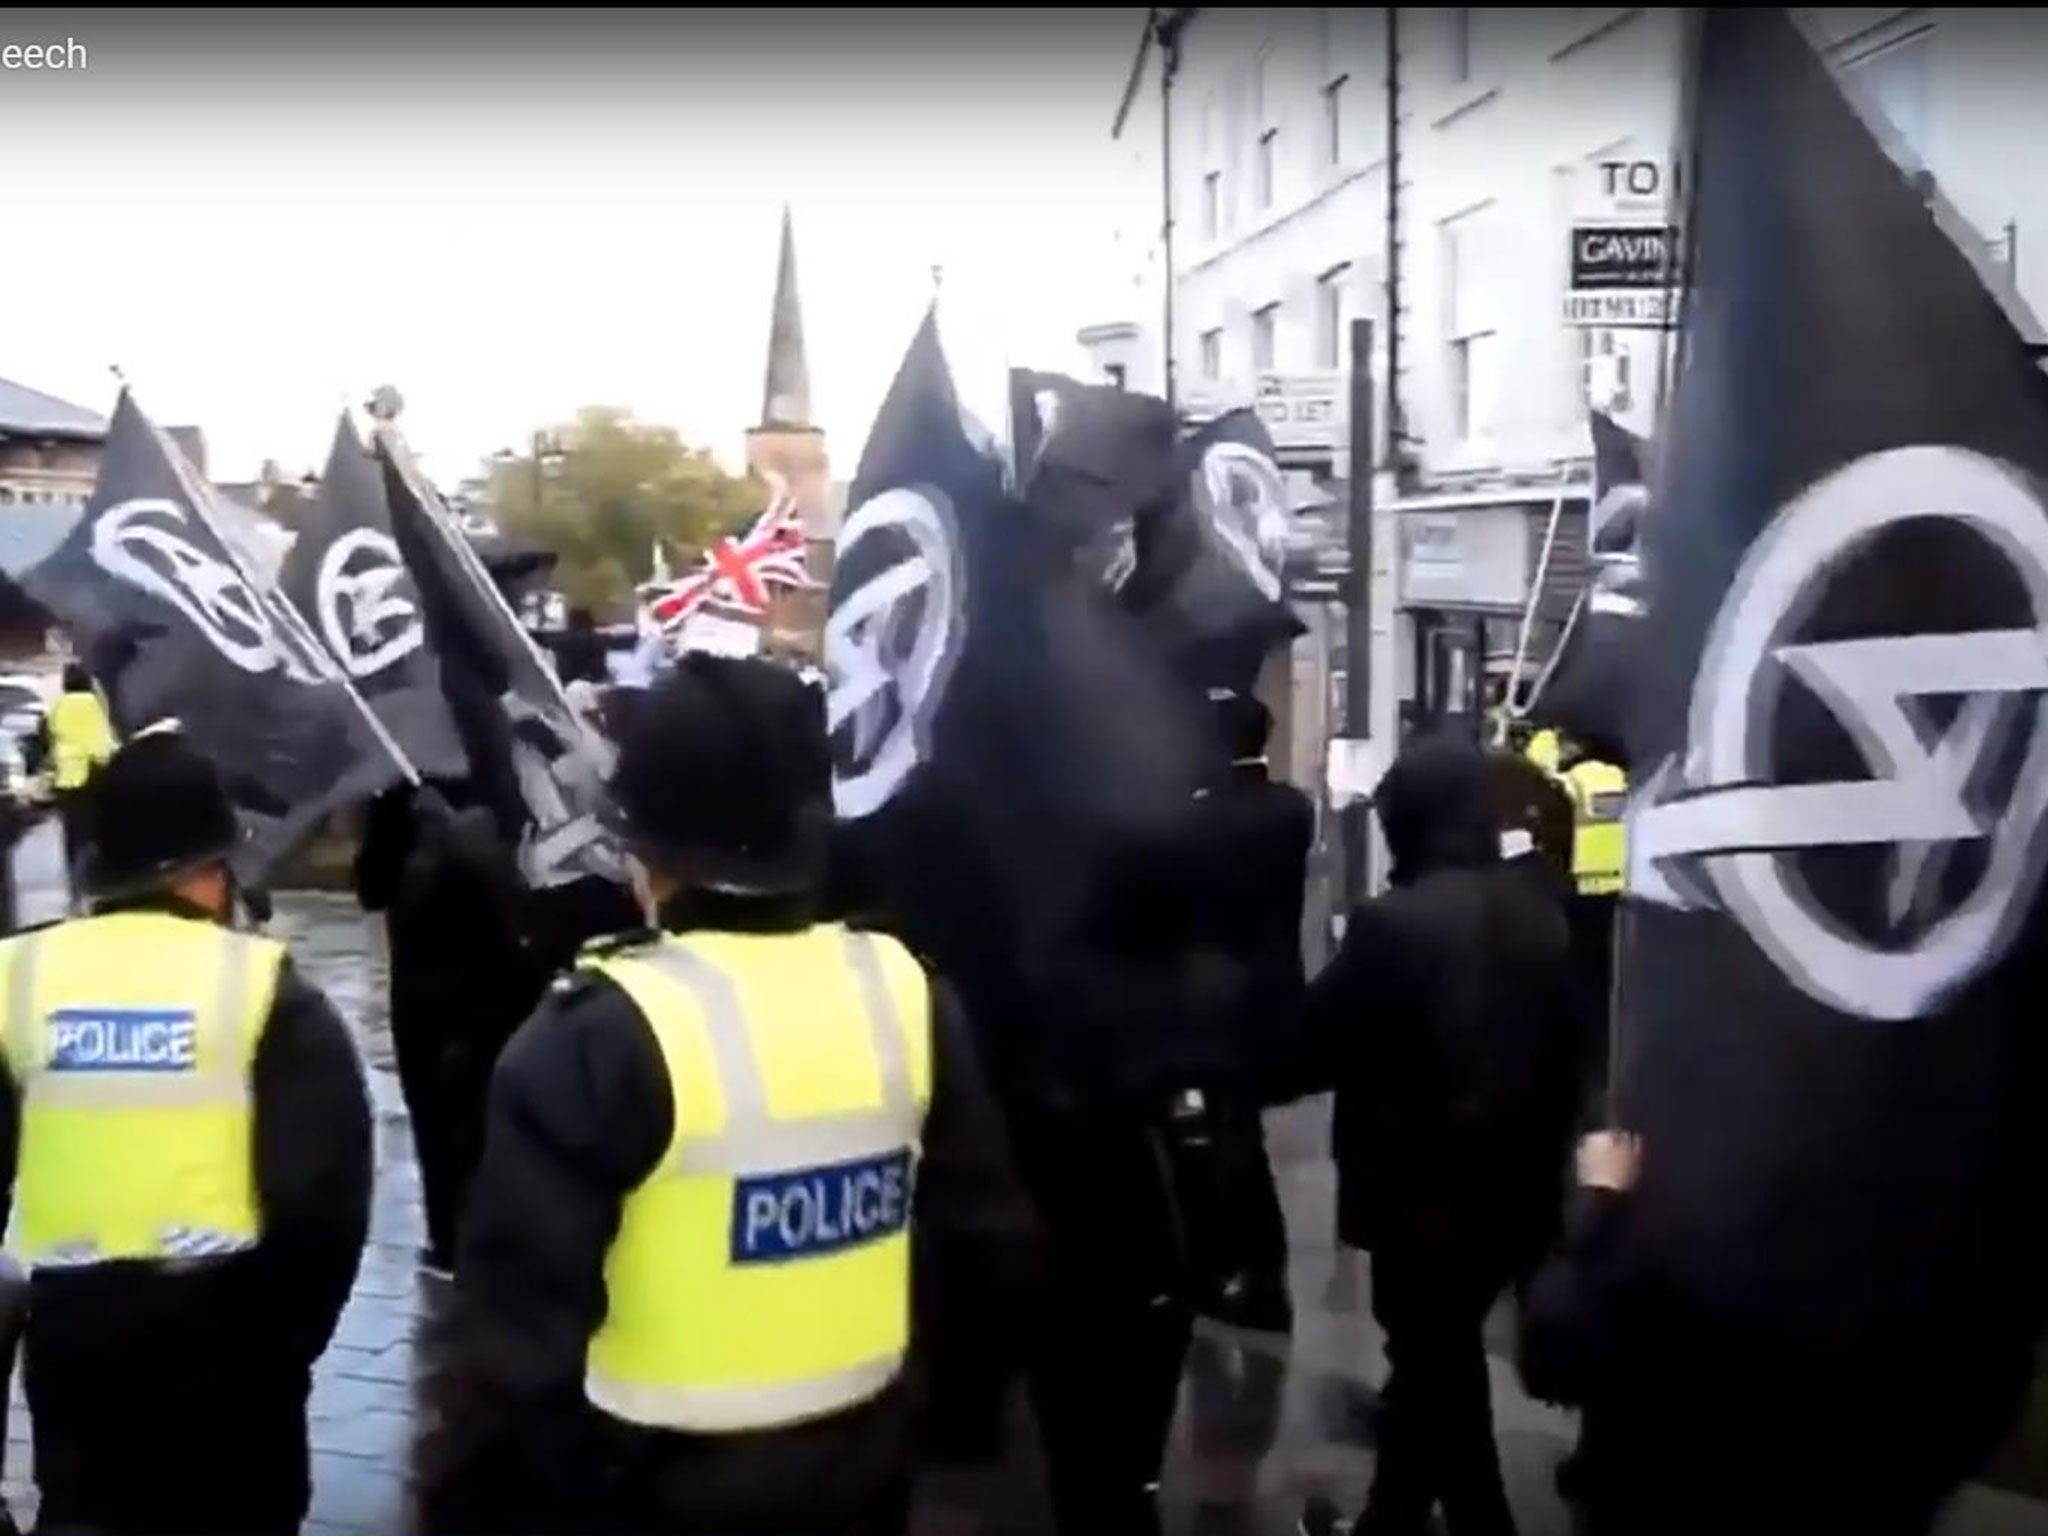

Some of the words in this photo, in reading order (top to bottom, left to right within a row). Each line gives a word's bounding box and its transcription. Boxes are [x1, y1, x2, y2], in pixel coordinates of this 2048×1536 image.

[1600, 161, 1659, 195] TO
[1295, 399, 1332, 422] LET
[49, 1019, 195, 1064] POLICE
[745, 1164, 905, 1251] POLICE
